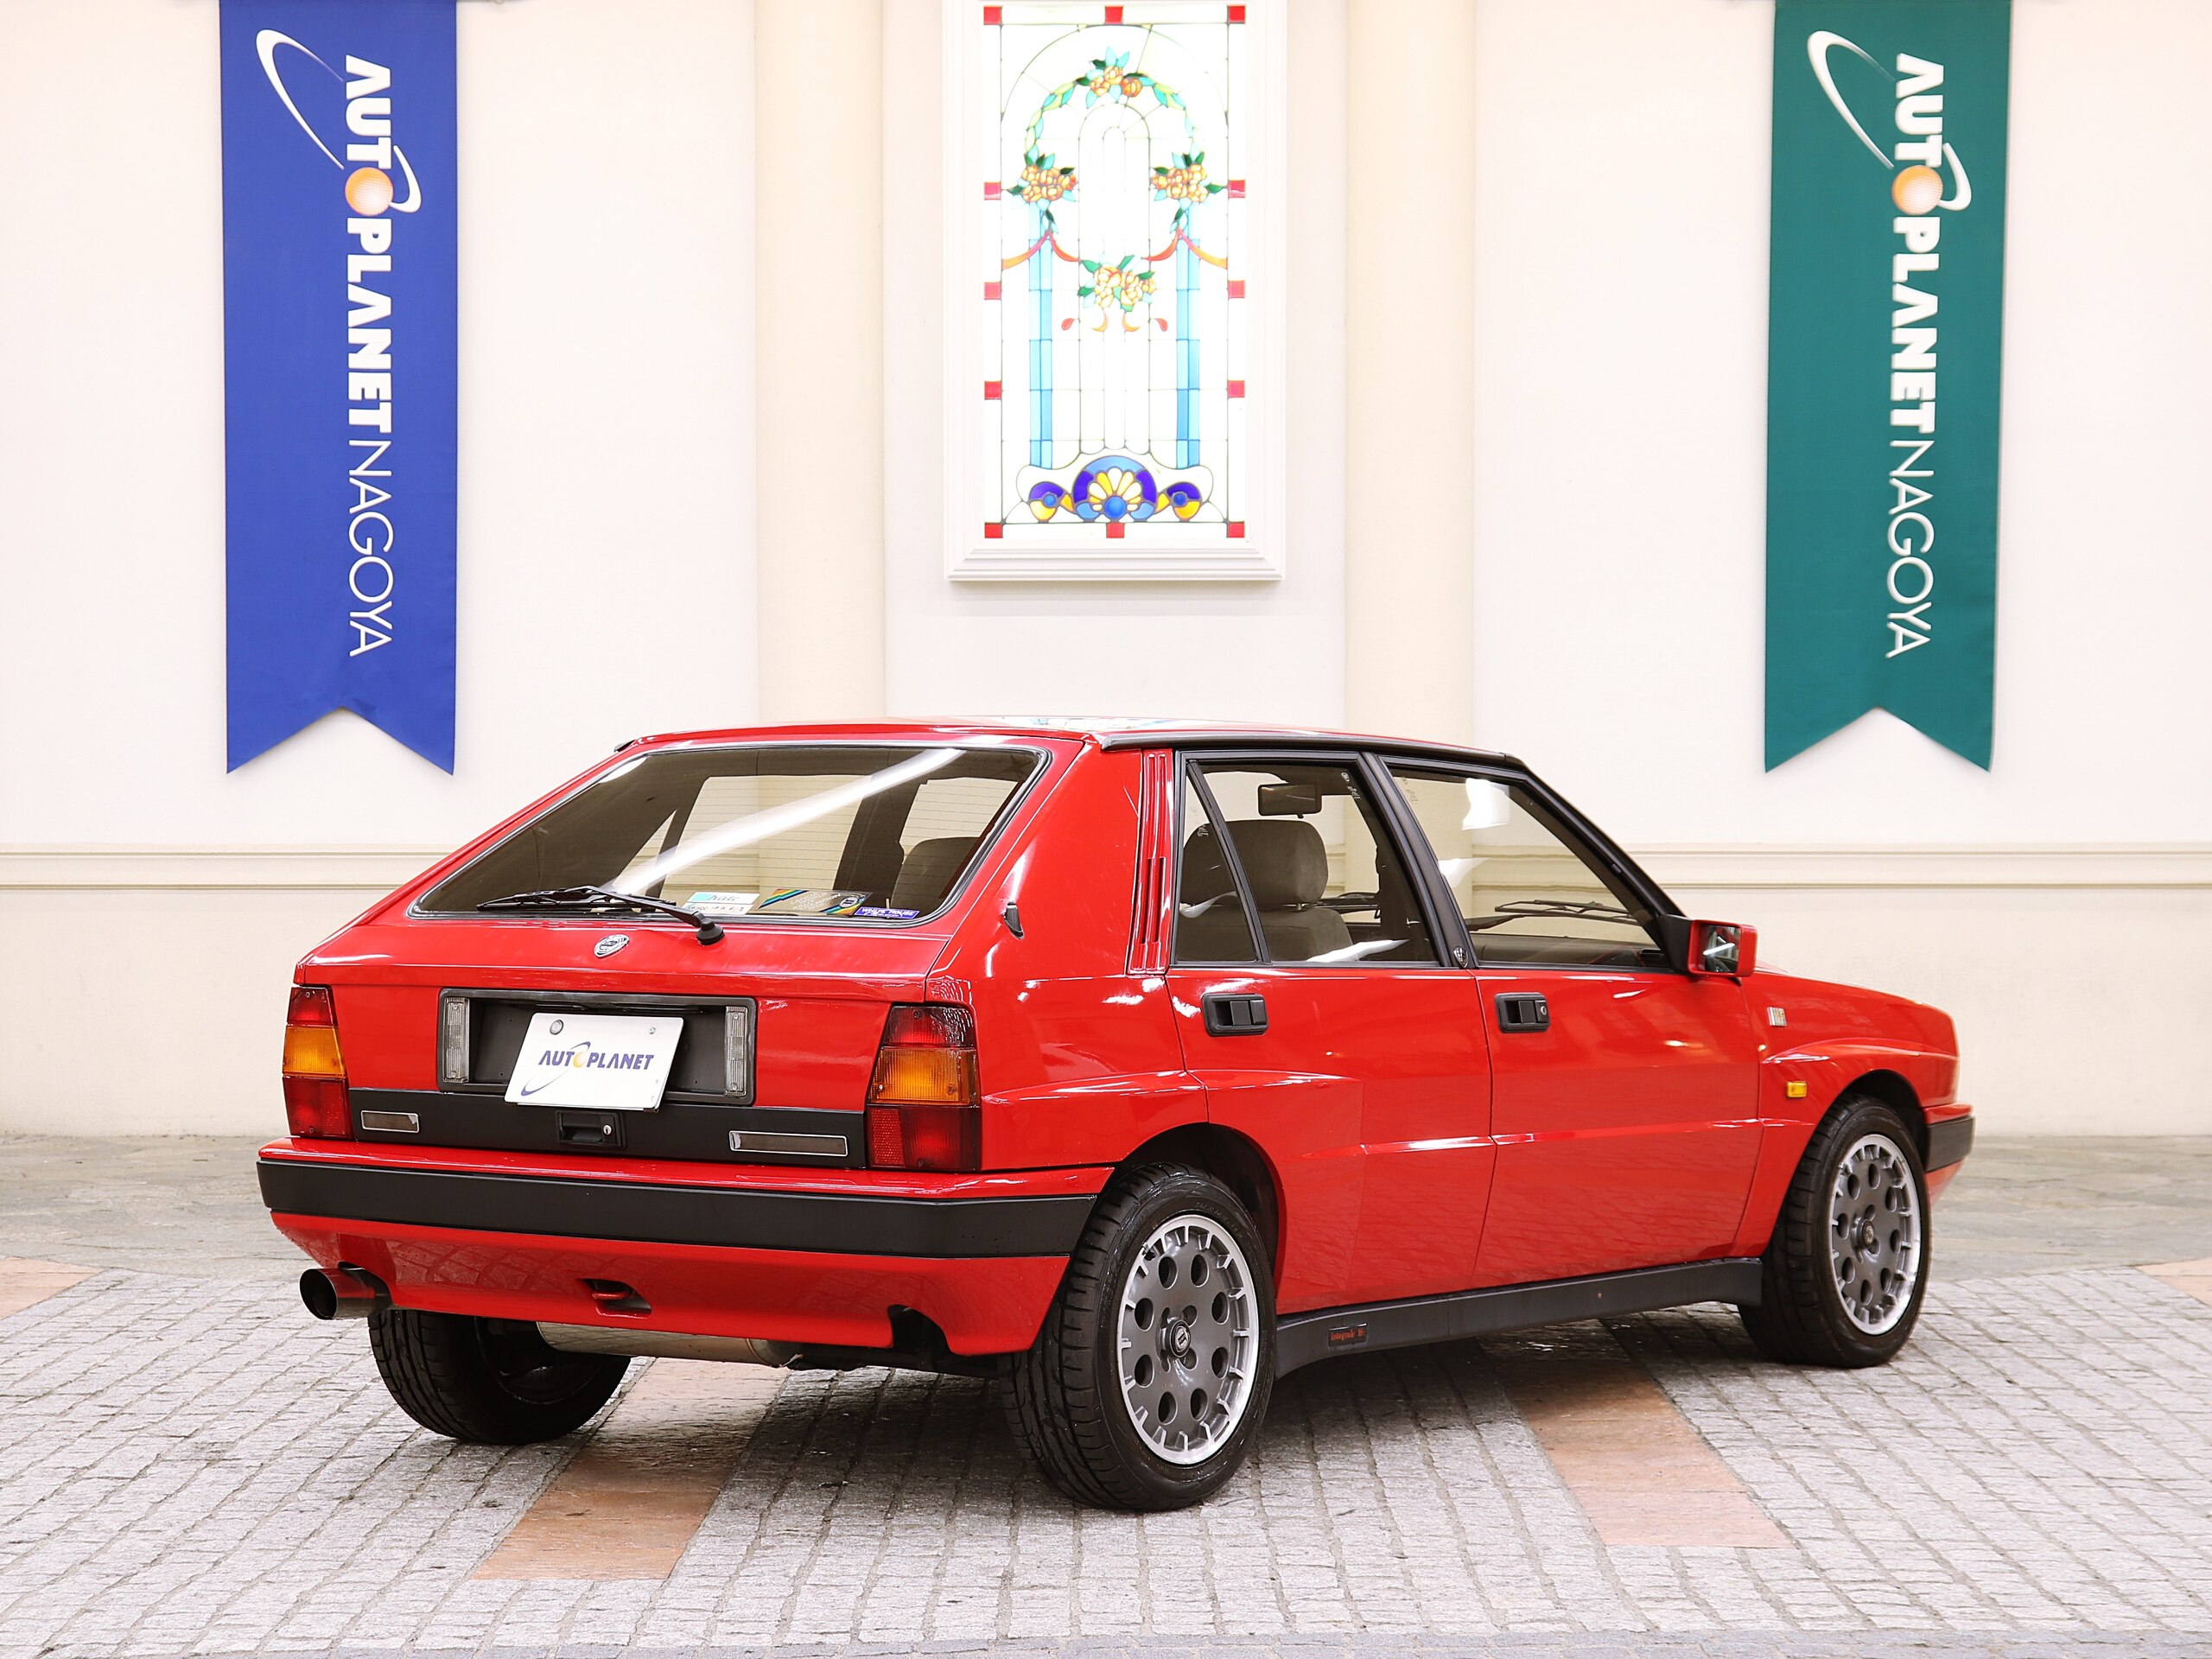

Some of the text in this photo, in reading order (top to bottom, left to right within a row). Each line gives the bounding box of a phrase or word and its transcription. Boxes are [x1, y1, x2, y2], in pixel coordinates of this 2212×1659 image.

[345, 54, 394, 657] AUTOPLANET NAGOYA
[1885, 53, 1944, 658] AUTOPLANET NAGOYA
[538, 1050, 654, 1071] AUTOPLANET
